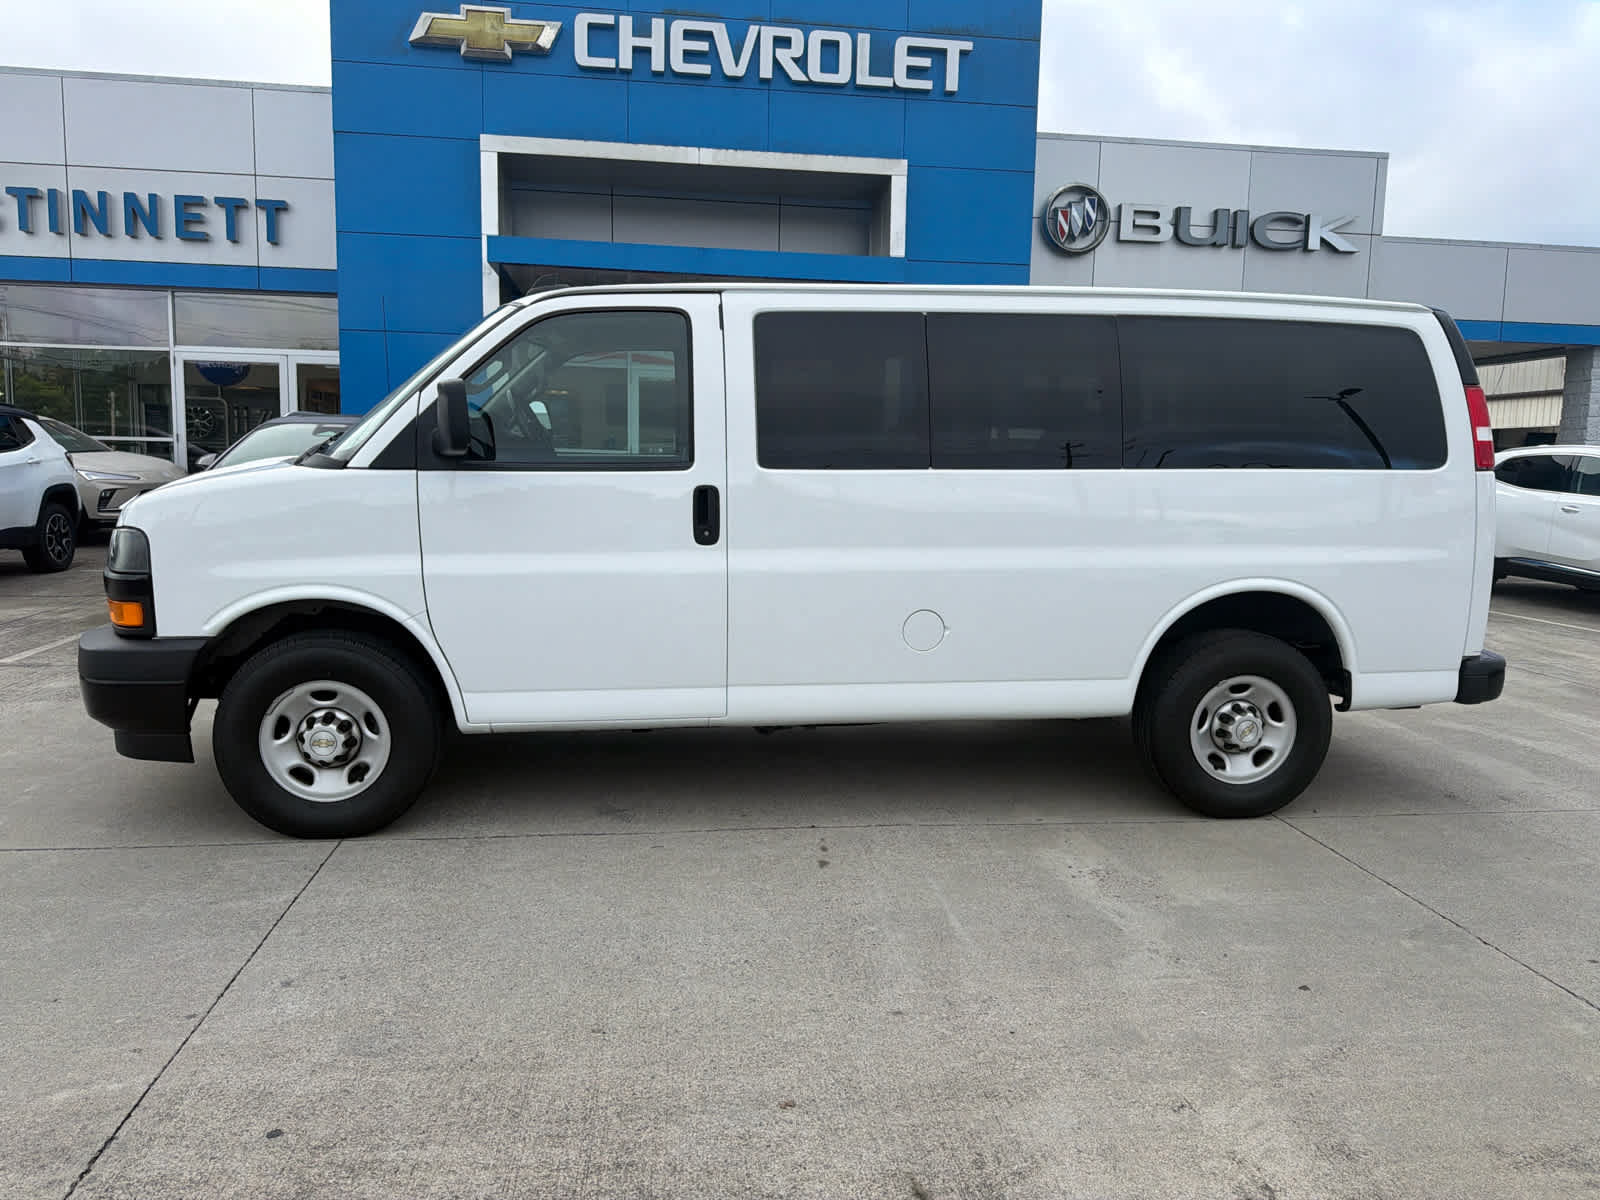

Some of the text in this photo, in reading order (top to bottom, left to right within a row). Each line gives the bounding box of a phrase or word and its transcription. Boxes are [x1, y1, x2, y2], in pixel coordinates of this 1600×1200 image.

[574, 12, 974, 93] CHEVROLET
[0, 186, 289, 245] TINNETT
[1117, 203, 1361, 255] BUICK
